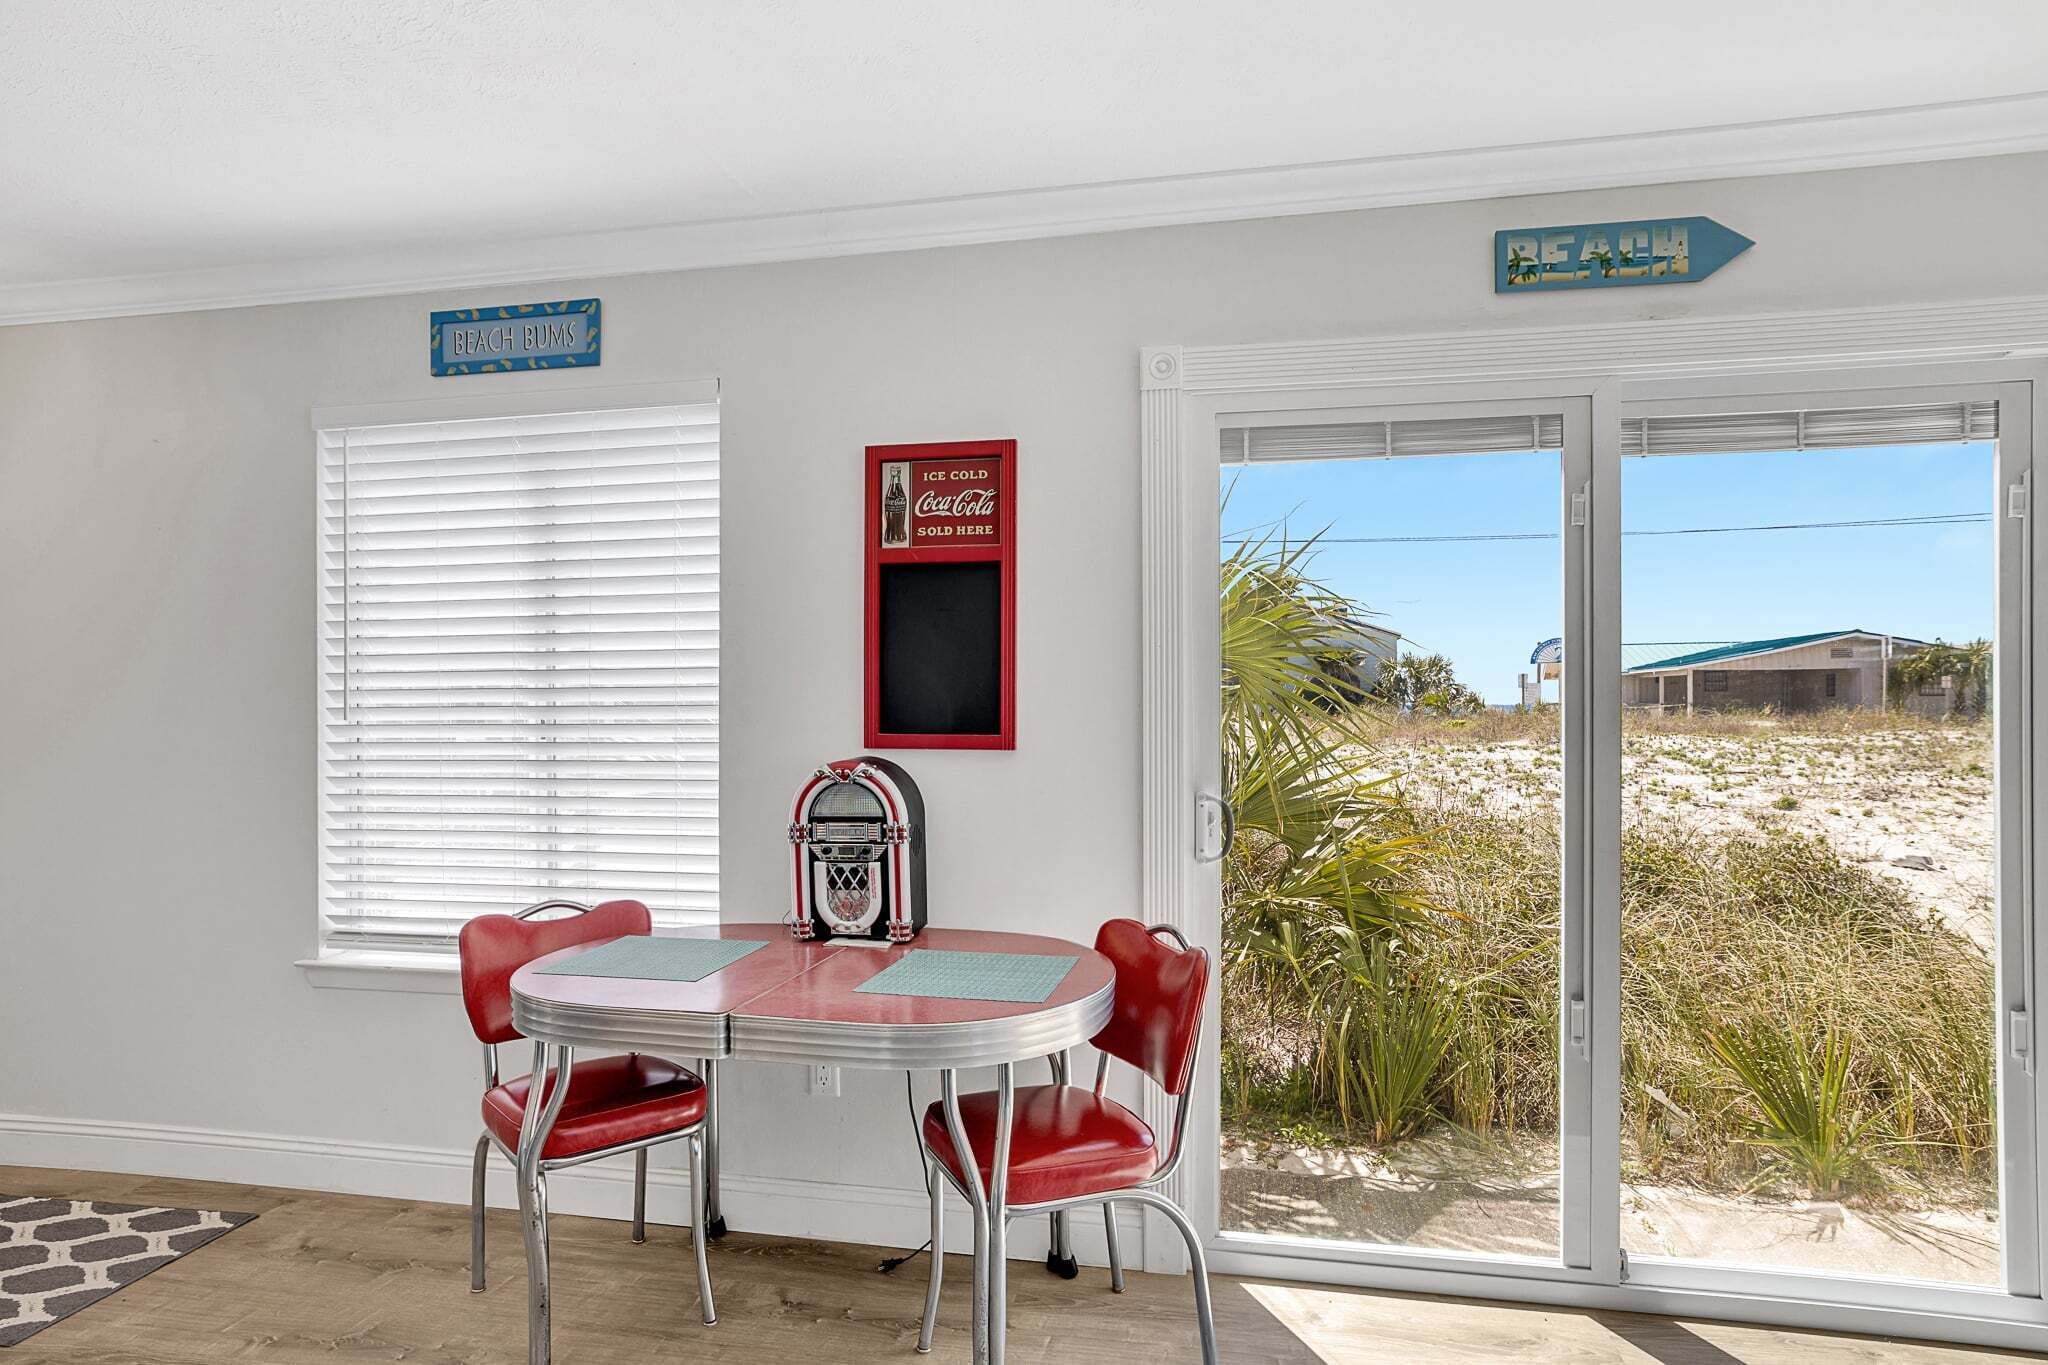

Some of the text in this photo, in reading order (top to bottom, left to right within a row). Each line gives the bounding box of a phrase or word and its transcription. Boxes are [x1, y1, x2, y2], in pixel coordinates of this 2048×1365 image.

[1507, 224, 1689, 286] BEACH
[453, 321, 576, 355] BEACH BUMS
[923, 470, 988, 481] ICE COLD
[914, 488, 998, 518] Coca-Cola
[917, 525, 993, 536] SOLD HERE
